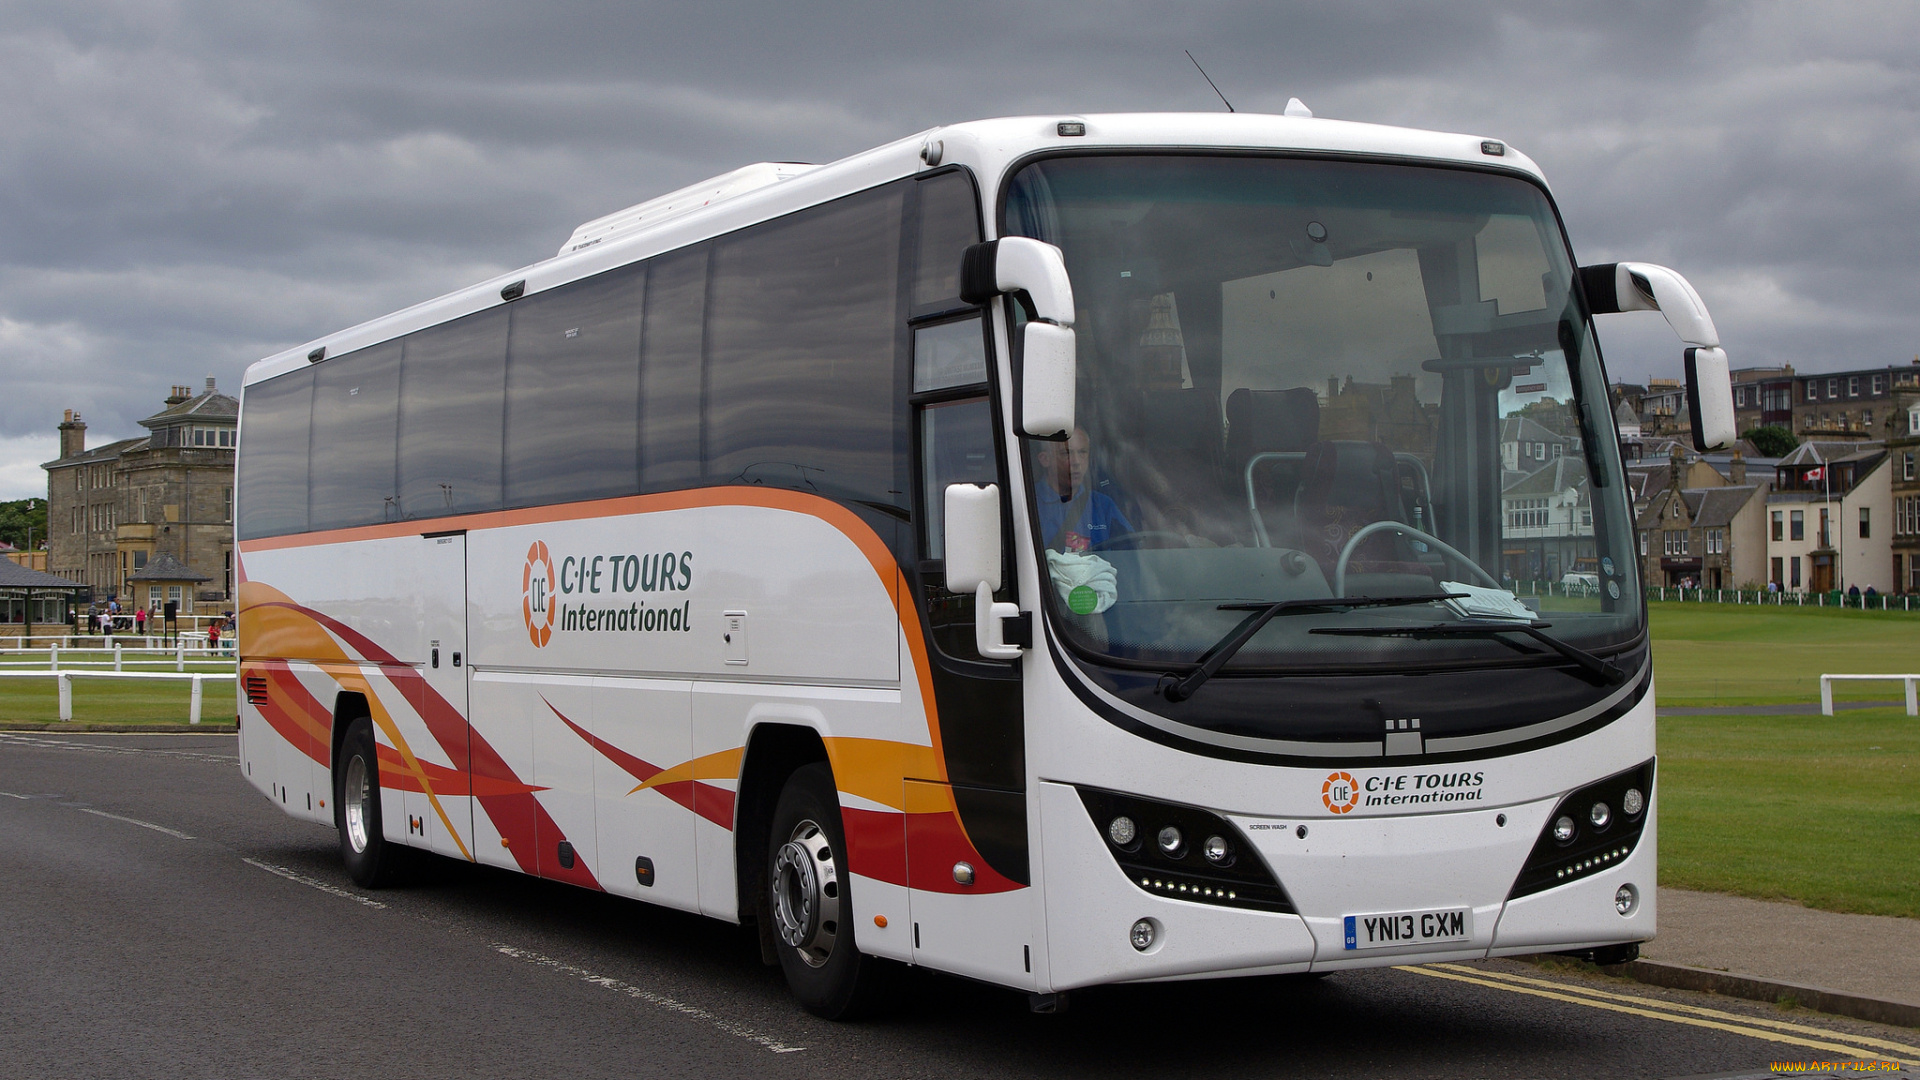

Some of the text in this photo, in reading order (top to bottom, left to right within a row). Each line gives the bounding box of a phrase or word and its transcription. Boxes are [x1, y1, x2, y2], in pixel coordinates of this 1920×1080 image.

[609, 551, 693, 592] TOURS
[532, 577, 546, 613] CIE
[561, 600, 691, 631] International
[1413, 771, 1484, 789] TOURS
[1333, 786, 1349, 801] CIE
[1365, 789, 1483, 806] International
[1364, 912, 1464, 942] YN13 GXM
[1346, 936, 1355, 944] GB
